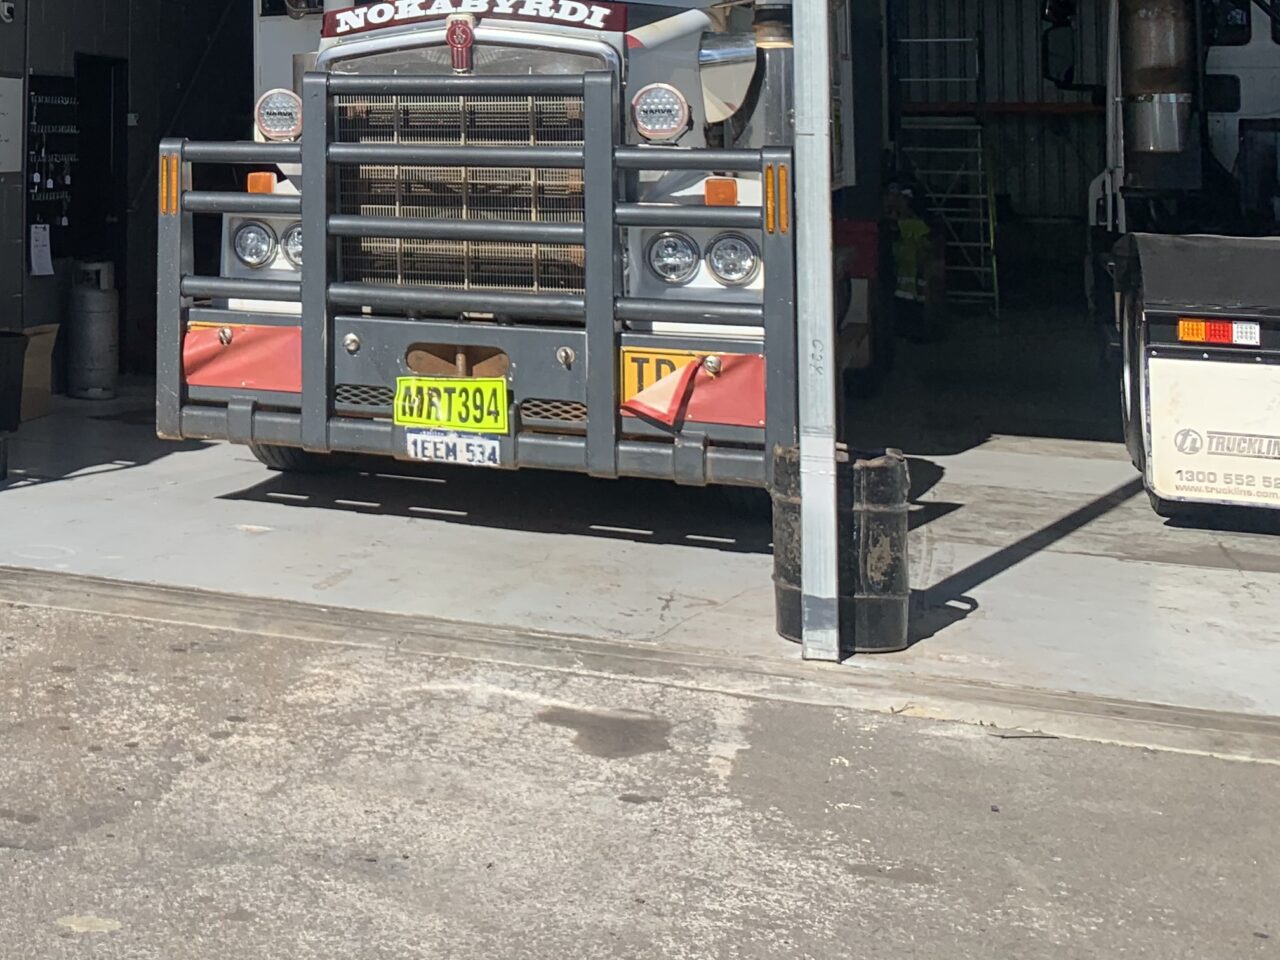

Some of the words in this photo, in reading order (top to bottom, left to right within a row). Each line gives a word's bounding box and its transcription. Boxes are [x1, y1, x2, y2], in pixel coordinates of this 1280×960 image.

[401, 385, 500, 424] MRT394
[465, 443, 498, 465] 534
[1175, 470, 1217, 483] 1300
[1223, 473, 1256, 487] 552
